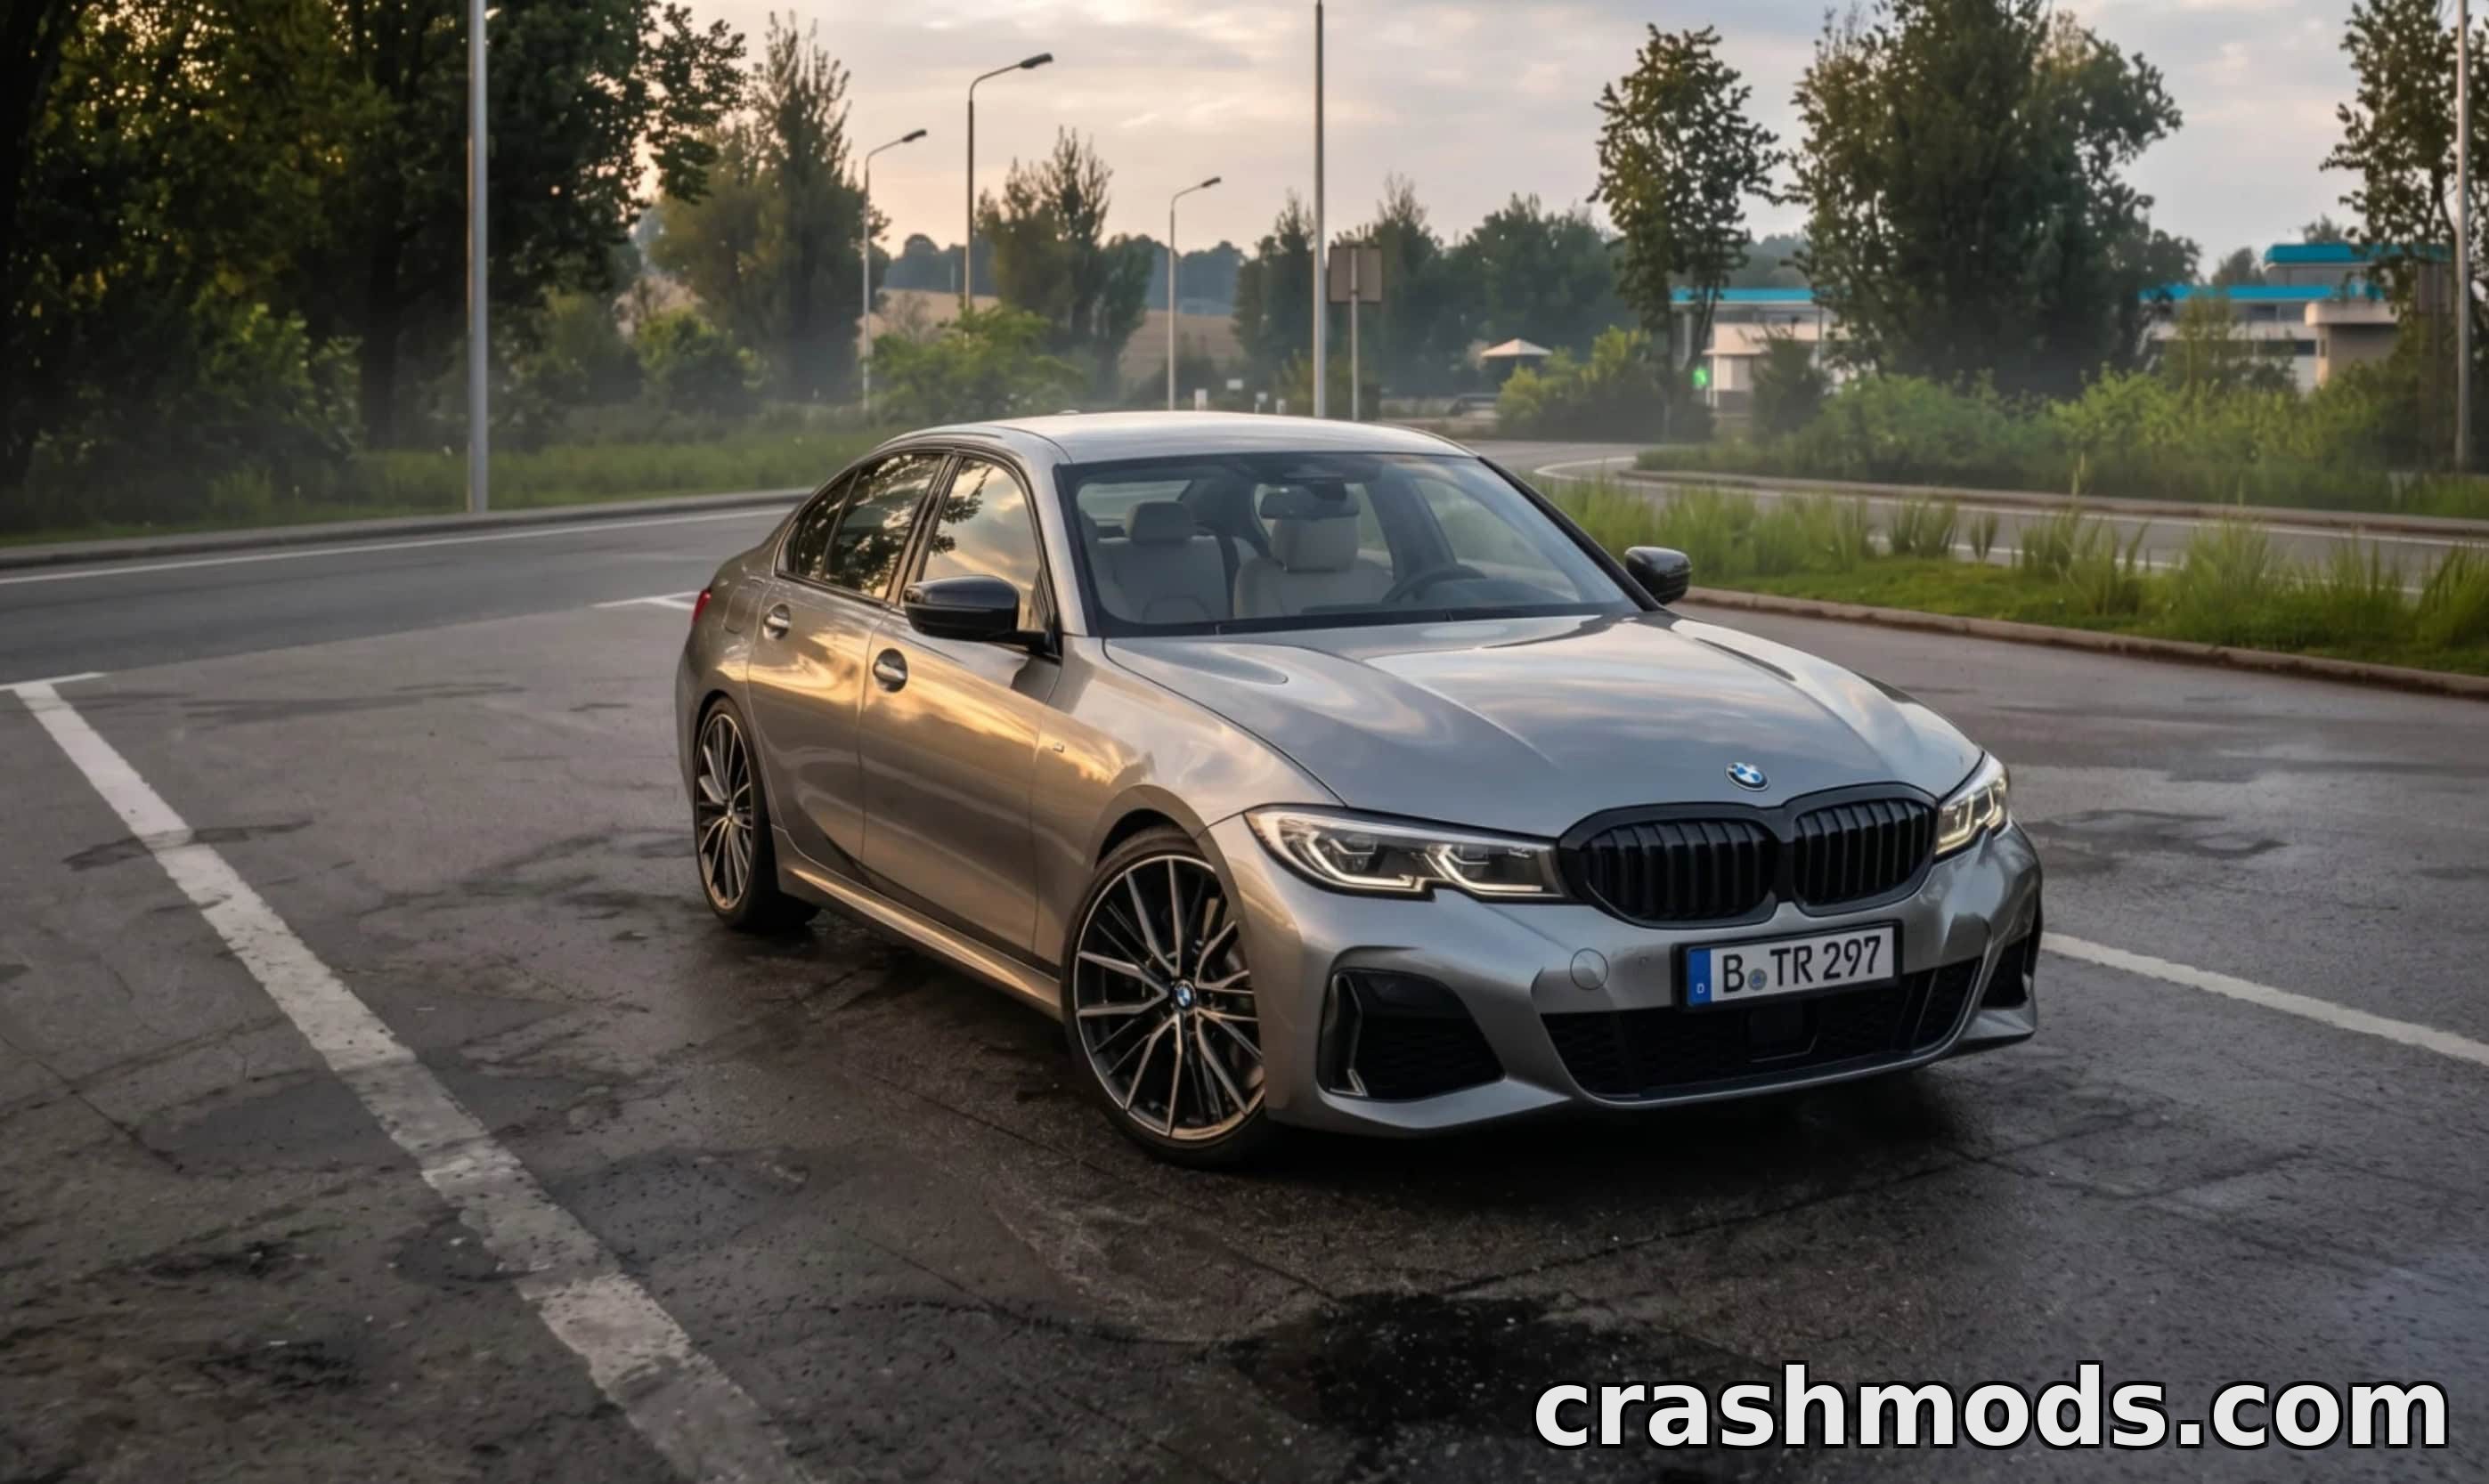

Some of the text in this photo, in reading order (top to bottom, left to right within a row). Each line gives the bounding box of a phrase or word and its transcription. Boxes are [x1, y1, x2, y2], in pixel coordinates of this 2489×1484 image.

[1722, 935, 1882, 993] B TR 297
[1696, 983, 1705, 994] D
